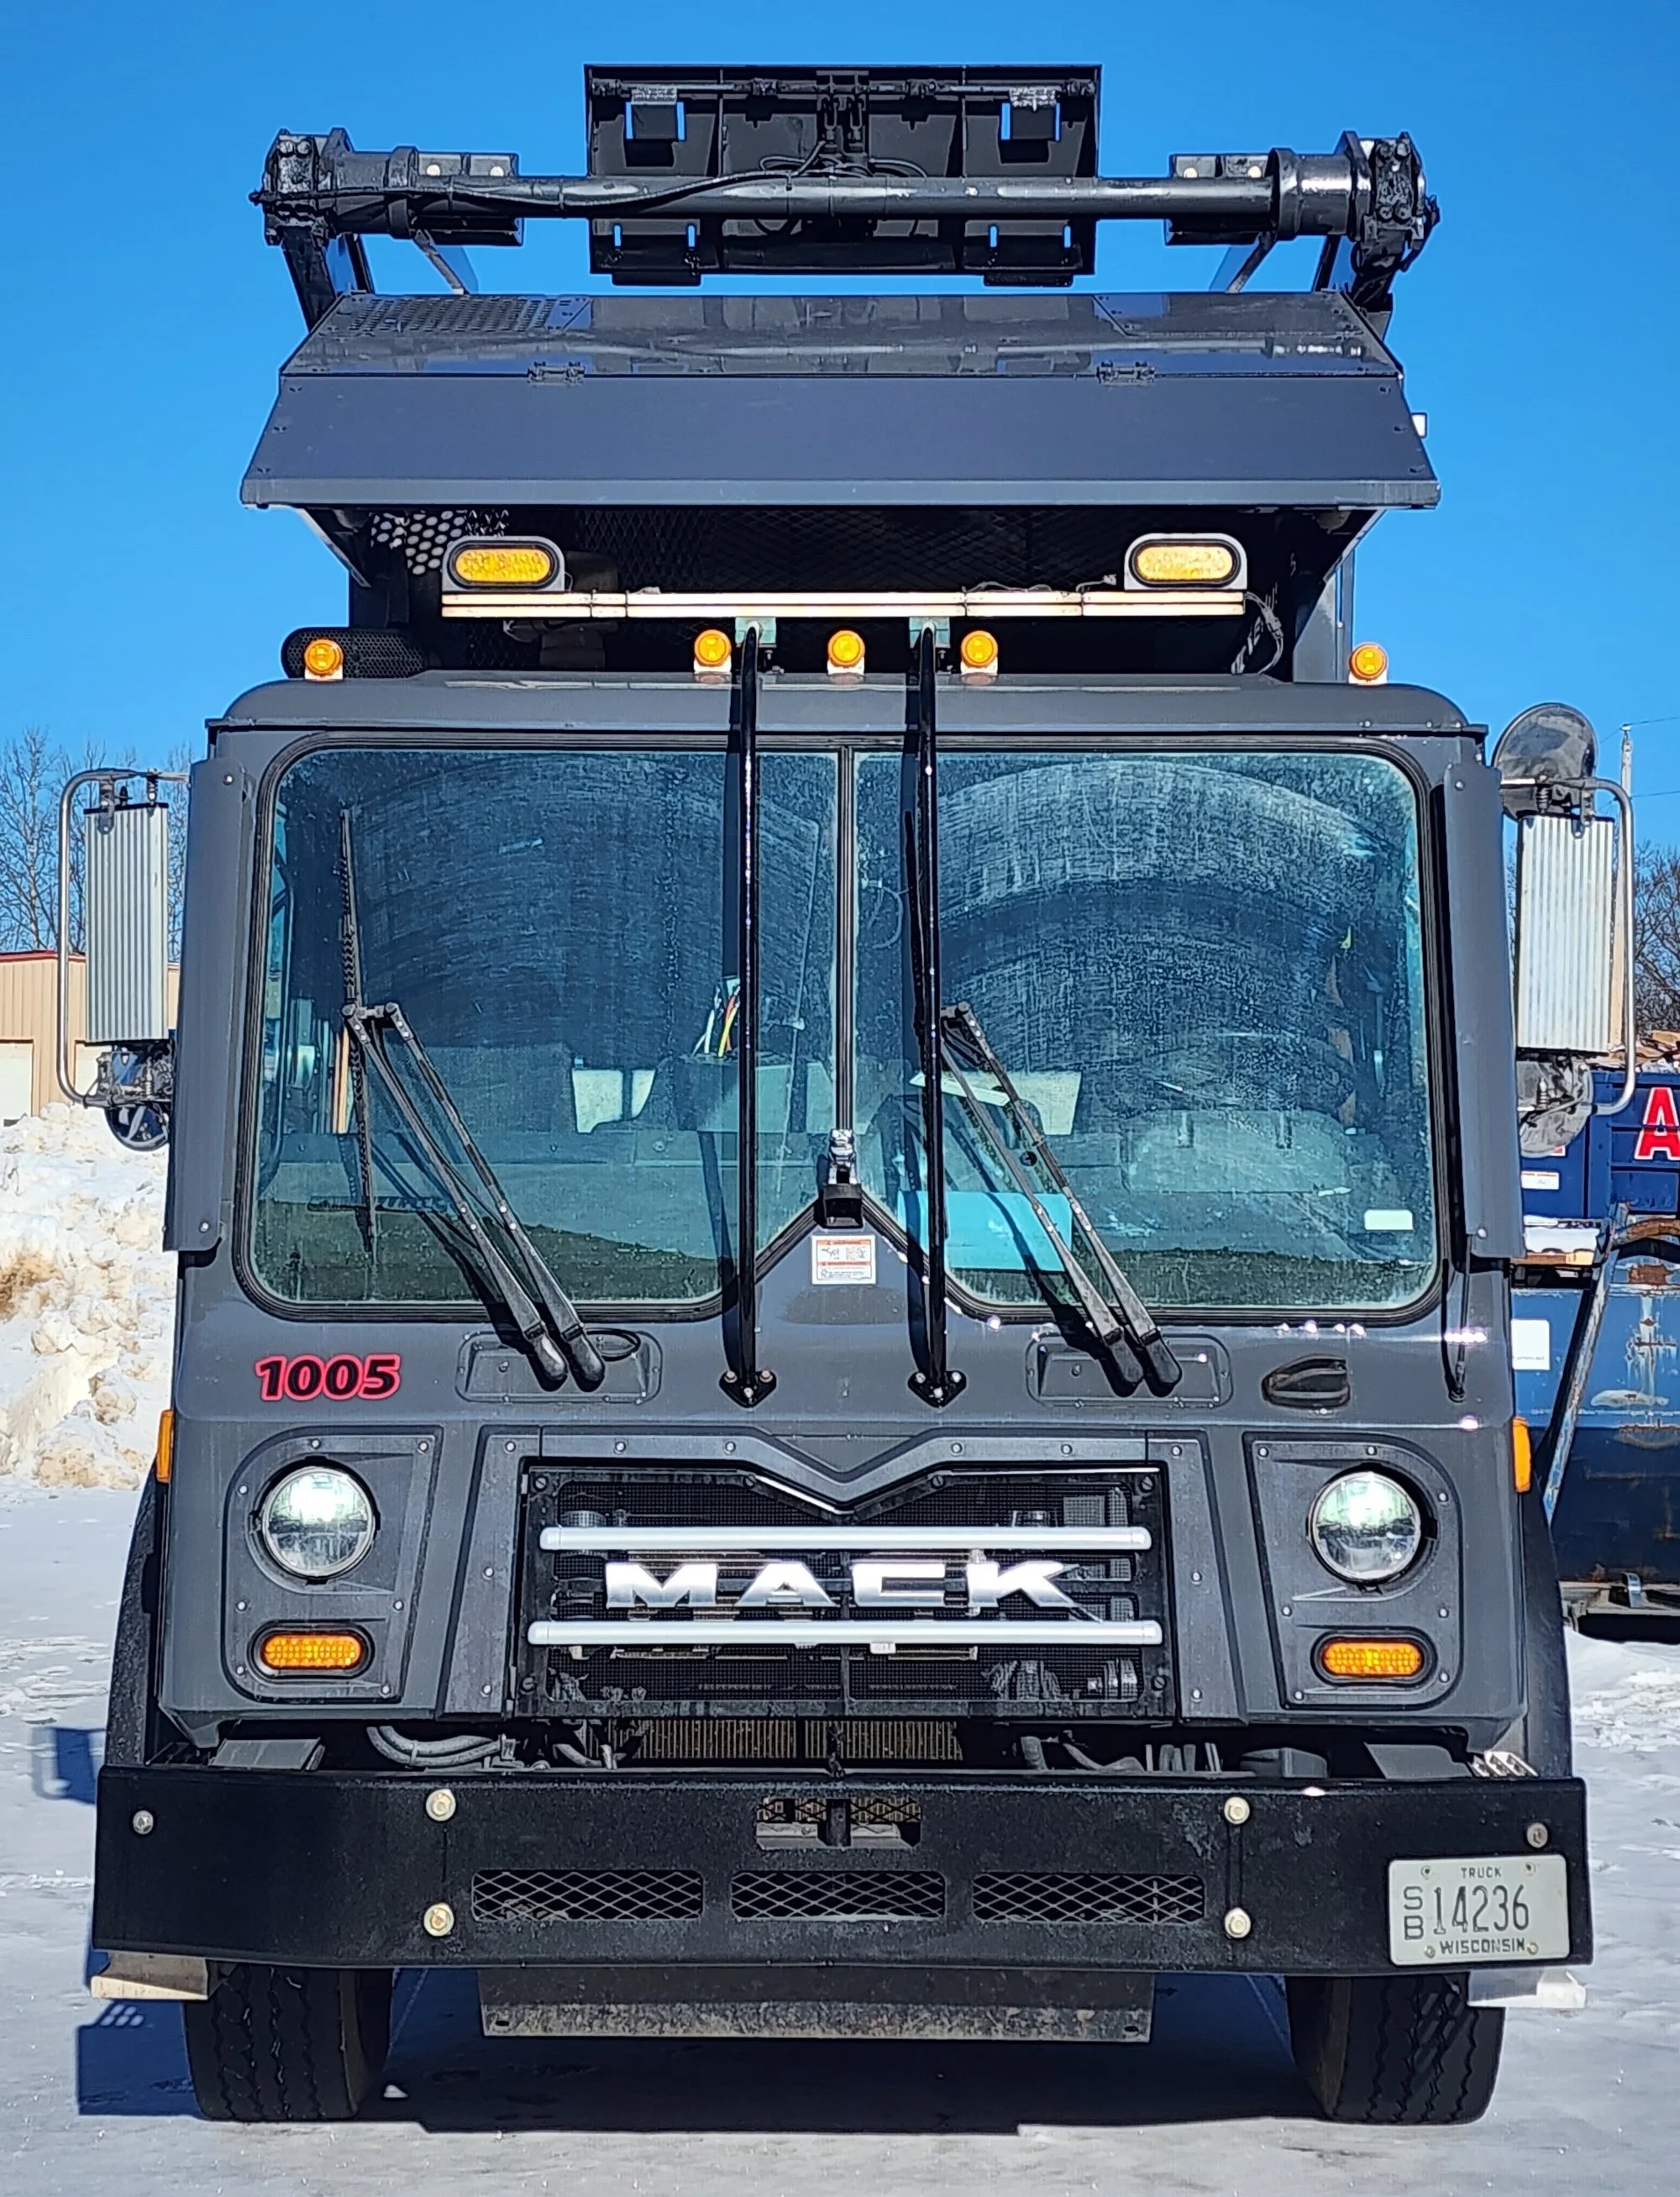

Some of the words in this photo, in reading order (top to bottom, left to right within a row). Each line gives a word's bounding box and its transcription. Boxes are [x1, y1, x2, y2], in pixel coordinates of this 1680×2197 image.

[255, 1353, 401, 1401] 1005
[606, 1561, 1077, 1608] MACK
[1461, 1866, 1502, 1879] TRUCK
[1433, 1884, 1530, 1935] 14236
[1439, 1937, 1525, 1955] WISCONSIN
